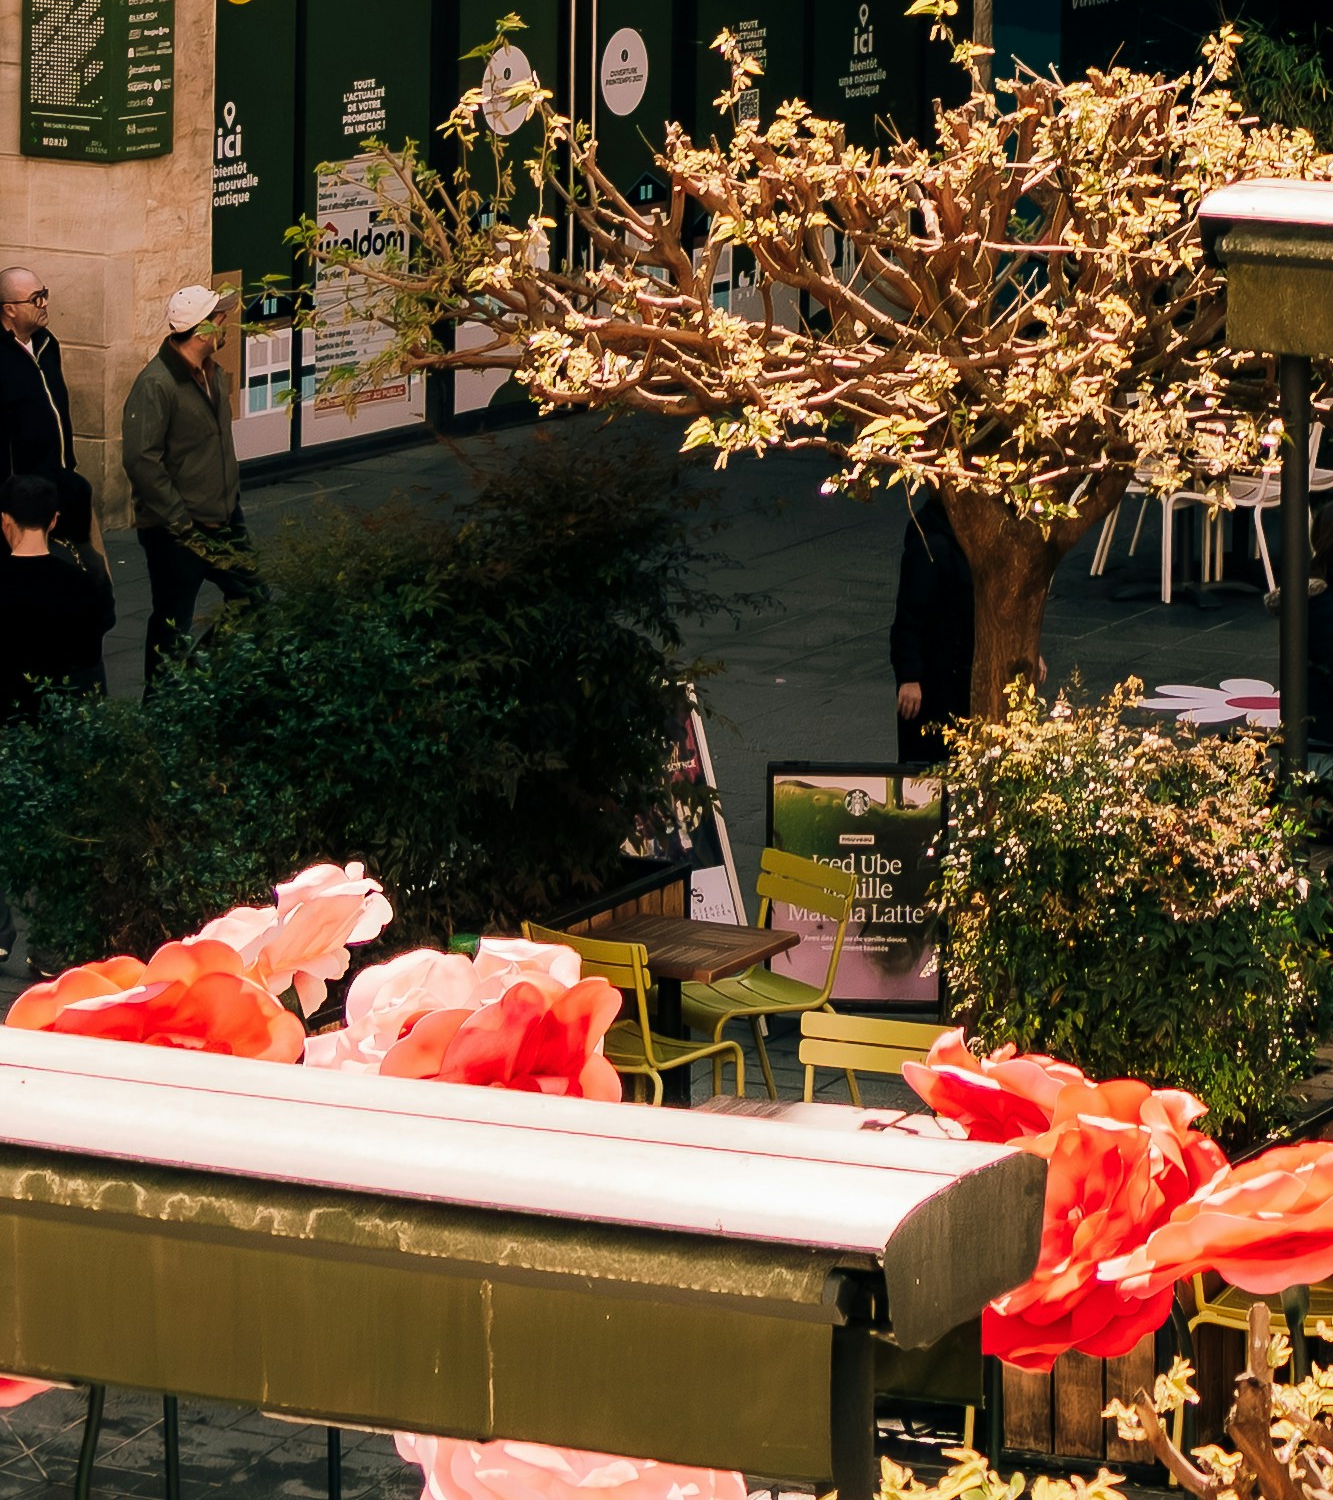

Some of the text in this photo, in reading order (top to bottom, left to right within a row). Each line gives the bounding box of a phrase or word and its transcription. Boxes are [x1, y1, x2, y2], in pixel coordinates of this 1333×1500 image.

[853, 25, 873, 55] ici
[850, 57, 877, 72] bientôt
[353, 79, 376, 89] TOUTE
[854, 70, 887, 84] nouvelle
[343, 86, 385, 102] L'ACTUALITÉ
[845, 84, 880, 98] boutique
[347, 100, 381, 113] DE VOTRE
[342, 110, 386, 124] PROMENADE
[344, 125, 354, 135] EN
[355, 124, 365, 133] UN
[217, 125, 242, 159] ici
[212, 161, 247, 179] bientôt
[218, 174, 259, 191] nouvelle
[213, 191, 250, 208] outique
[861, 854, 902, 875] Ube
[872, 903, 924, 924] Latte
